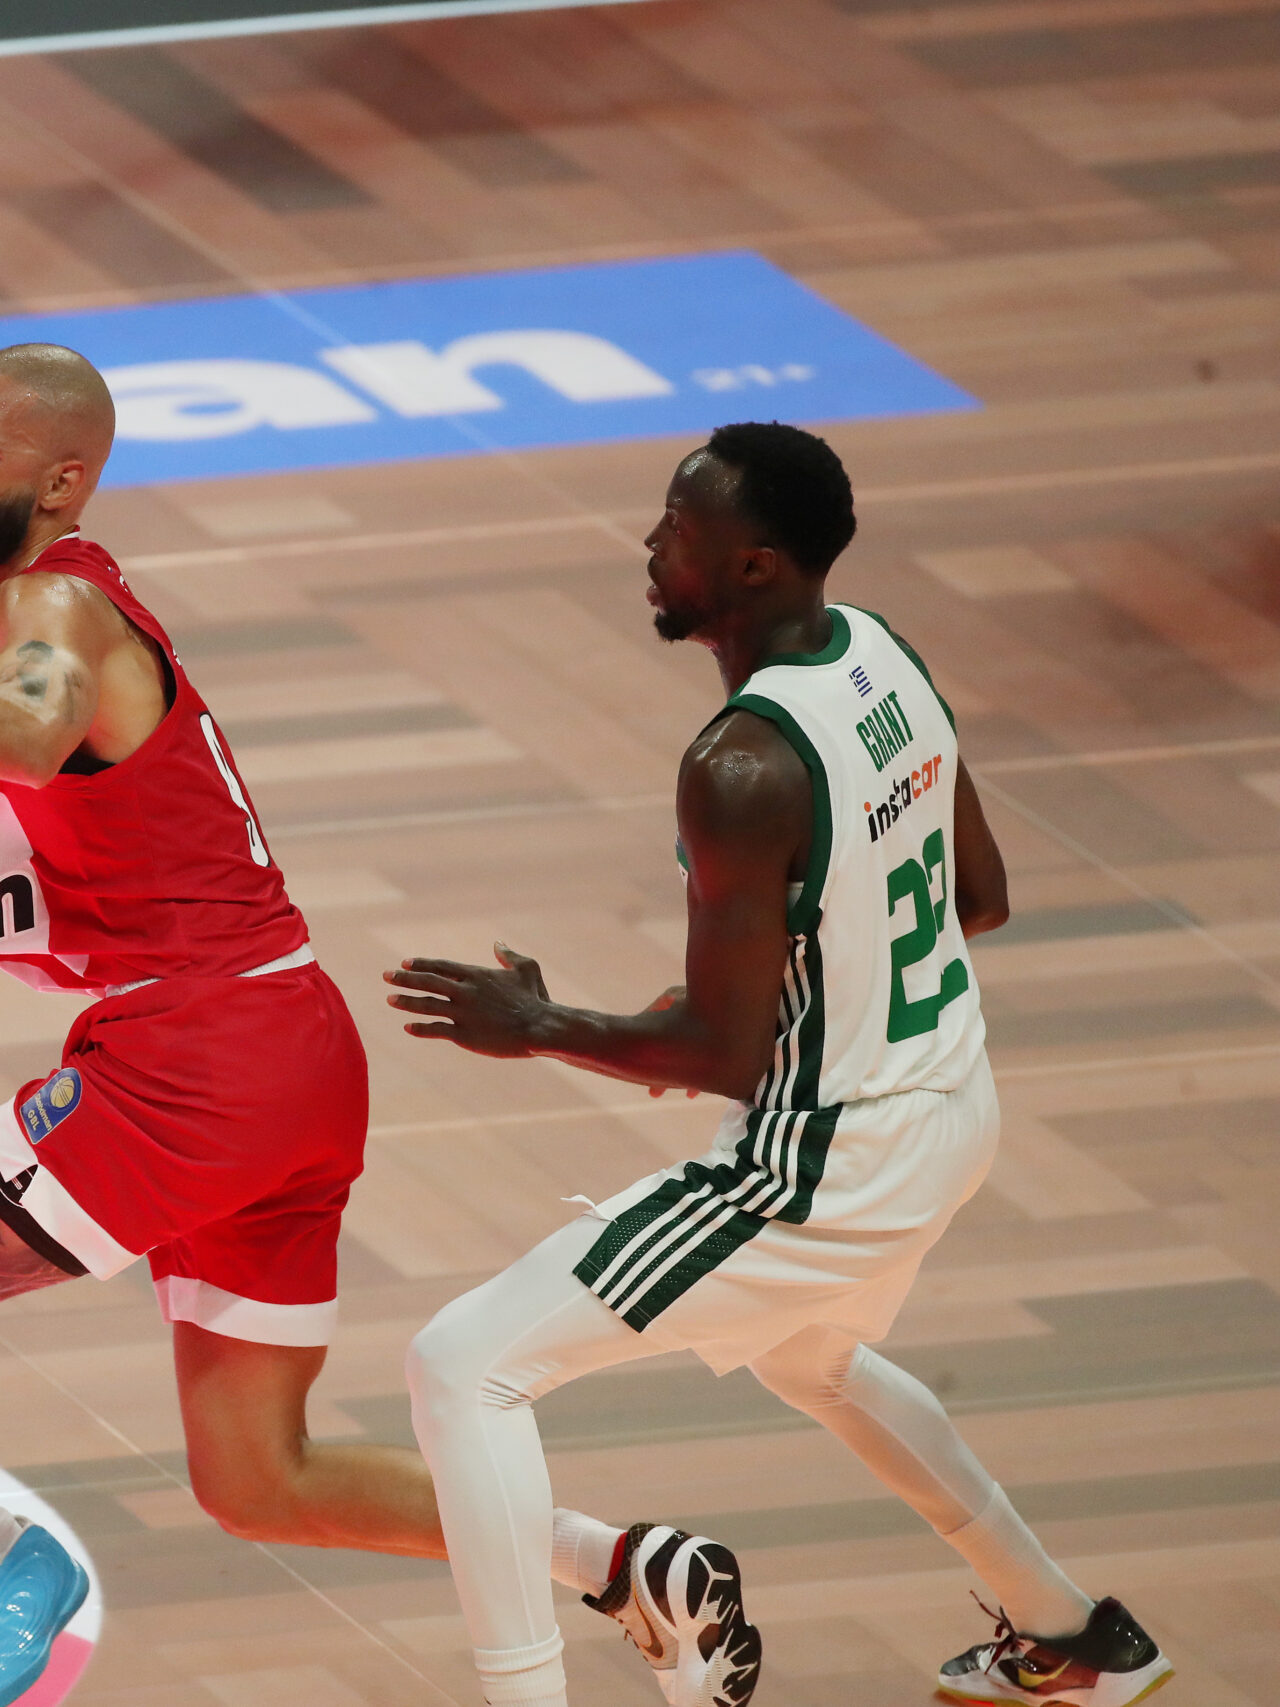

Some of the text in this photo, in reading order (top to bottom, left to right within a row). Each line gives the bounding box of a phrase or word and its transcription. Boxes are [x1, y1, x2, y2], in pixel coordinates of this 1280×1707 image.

[856, 690, 914, 773] GRANT
[864, 754, 942, 843] instacar
[886, 827, 969, 1043] 22
[27, 1109, 40, 1131] GBL
